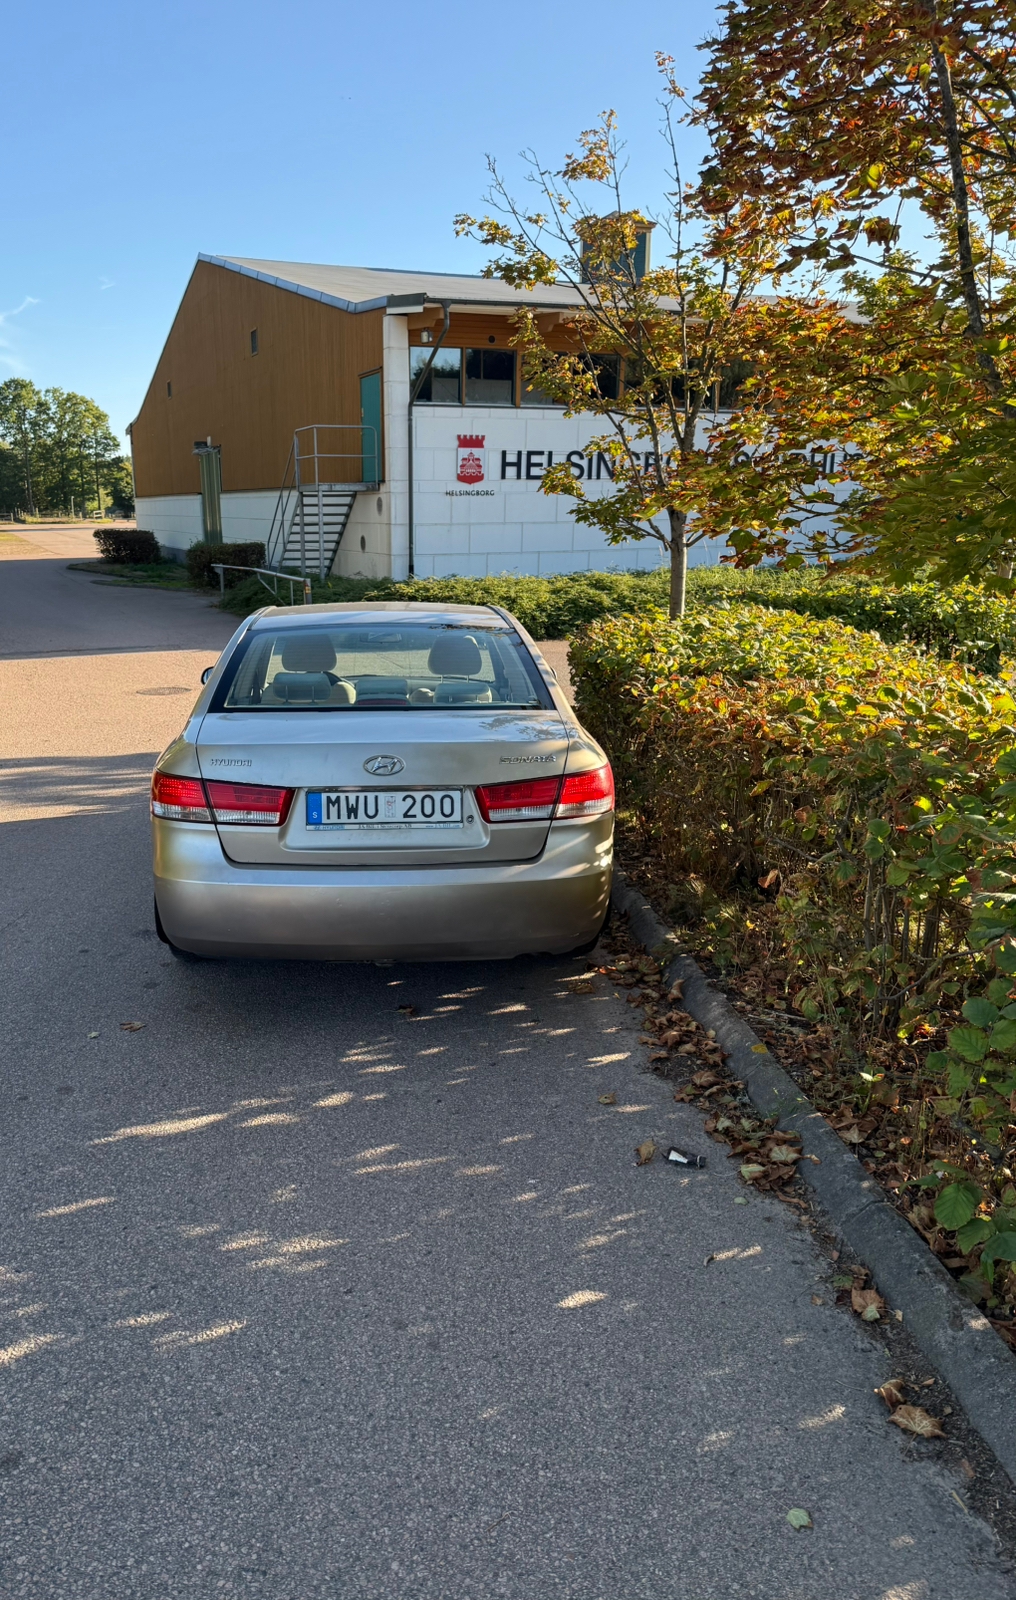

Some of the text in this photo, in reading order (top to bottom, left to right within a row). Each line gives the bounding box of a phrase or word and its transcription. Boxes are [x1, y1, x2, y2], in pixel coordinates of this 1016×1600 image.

[210, 758, 253, 767] HYUNDAI
[499, 754, 557, 765] SONATA
[326, 794, 455, 820] MWU 200
[312, 811, 318, 819] S
